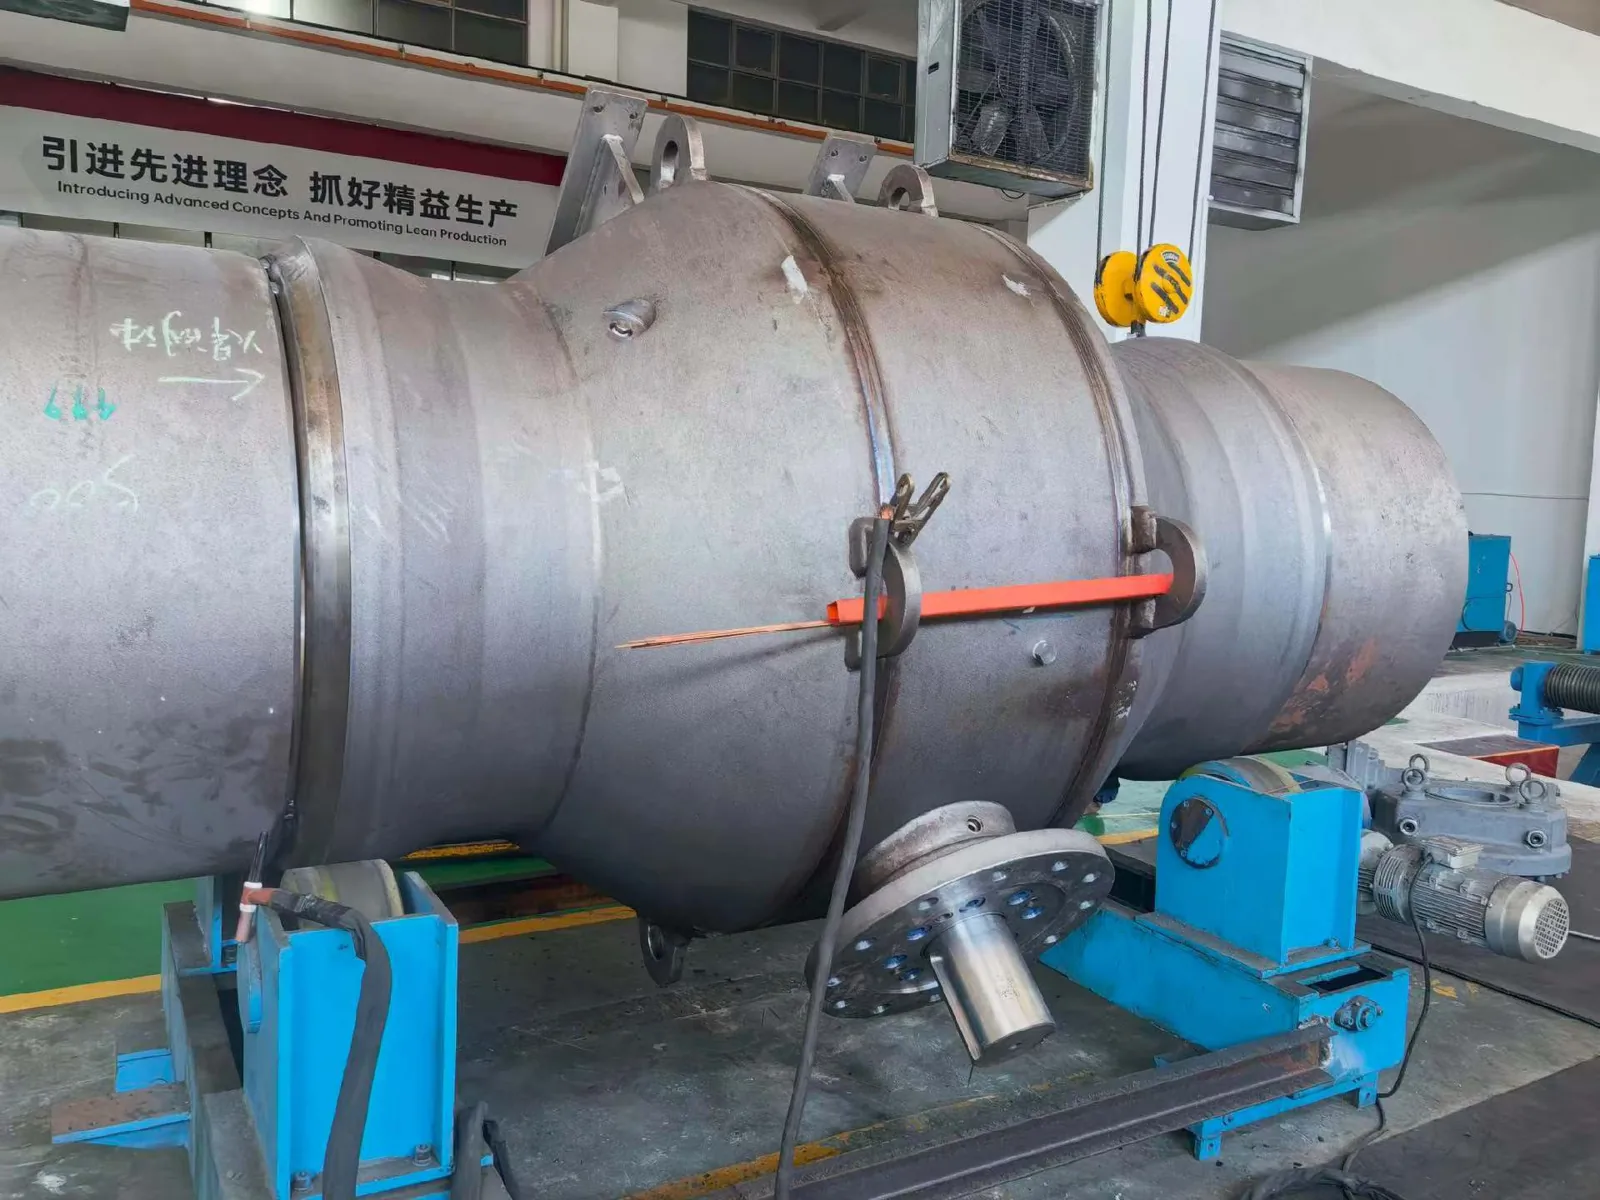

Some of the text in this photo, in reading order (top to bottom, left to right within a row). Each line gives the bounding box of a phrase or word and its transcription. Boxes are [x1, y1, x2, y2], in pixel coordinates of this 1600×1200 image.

[43, 136, 518, 228] 引进先进理念 抓好精益生产
[57, 180, 507, 246] Introducing Advanced Concepts And Promoting Lean Production
